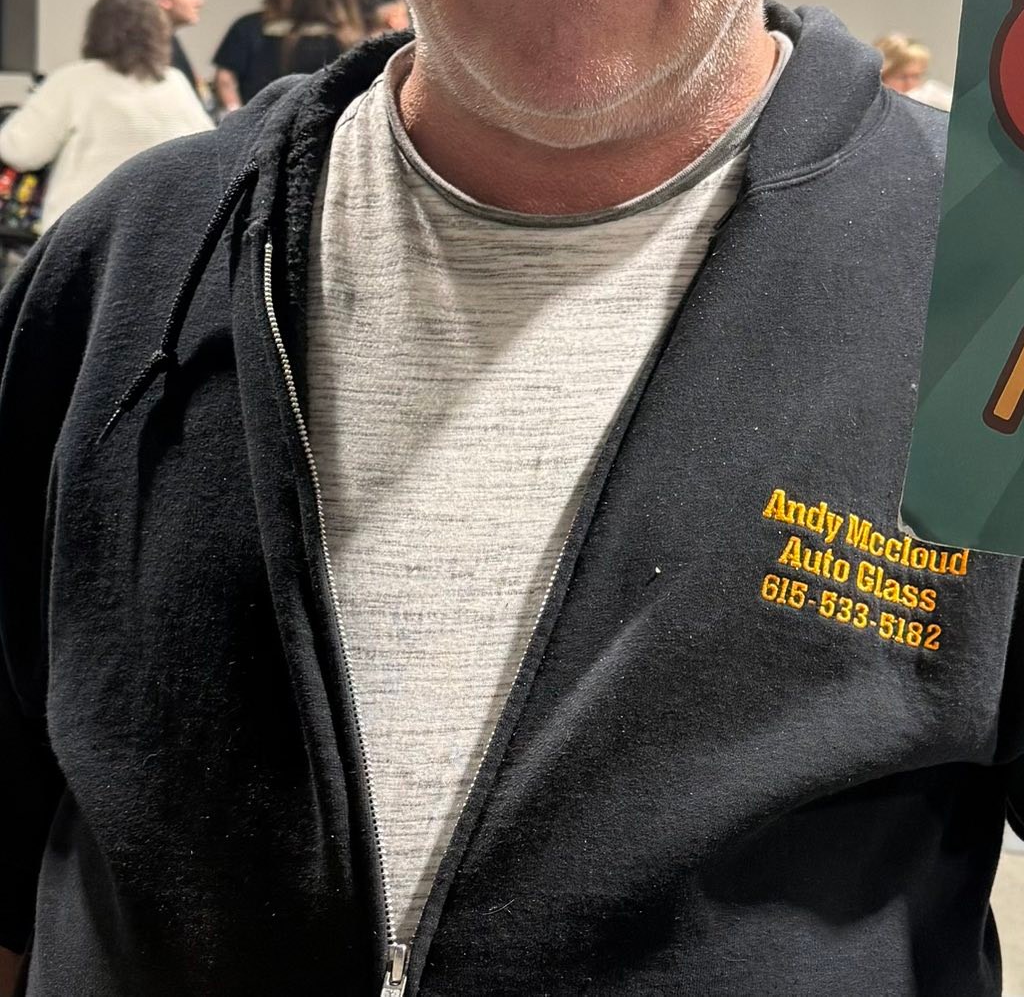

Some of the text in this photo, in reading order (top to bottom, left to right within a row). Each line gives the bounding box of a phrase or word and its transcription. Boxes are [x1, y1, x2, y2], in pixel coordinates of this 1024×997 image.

[762, 489, 969, 576] Andy Mccloud
[760, 573, 942, 650] 615-533-5182
[778, 535, 937, 613] Auto Glass
